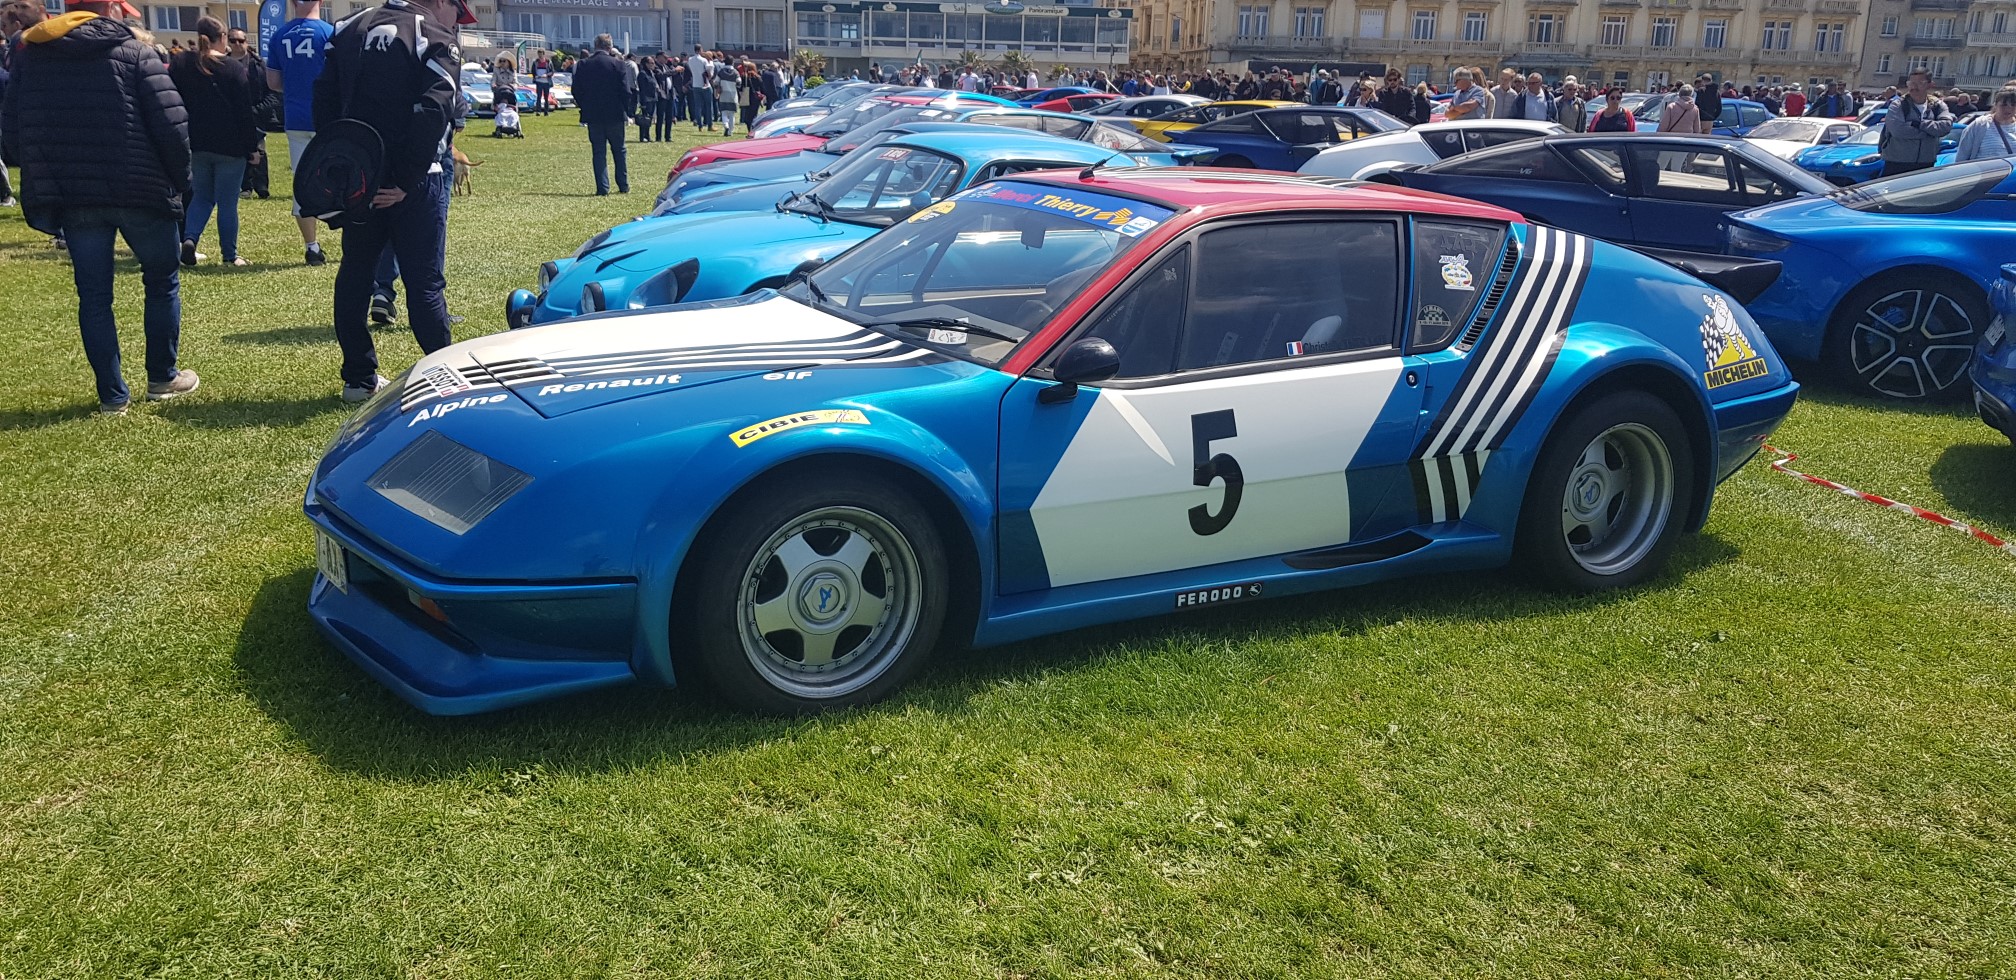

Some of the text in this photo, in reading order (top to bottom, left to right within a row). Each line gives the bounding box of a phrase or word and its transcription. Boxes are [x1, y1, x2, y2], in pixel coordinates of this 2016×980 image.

[281, 37, 315, 59] 14
[1033, 194, 1101, 217] Thierry
[425, 367, 459, 390] TISSOT
[538, 374, 682, 396] Renault
[1706, 360, 1767, 388] MICHELIN
[407, 394, 508, 428] Alpine
[739, 414, 819, 440] CIBIE
[1187, 408, 1245, 537] 5
[1177, 586, 1242, 607] FERODO
